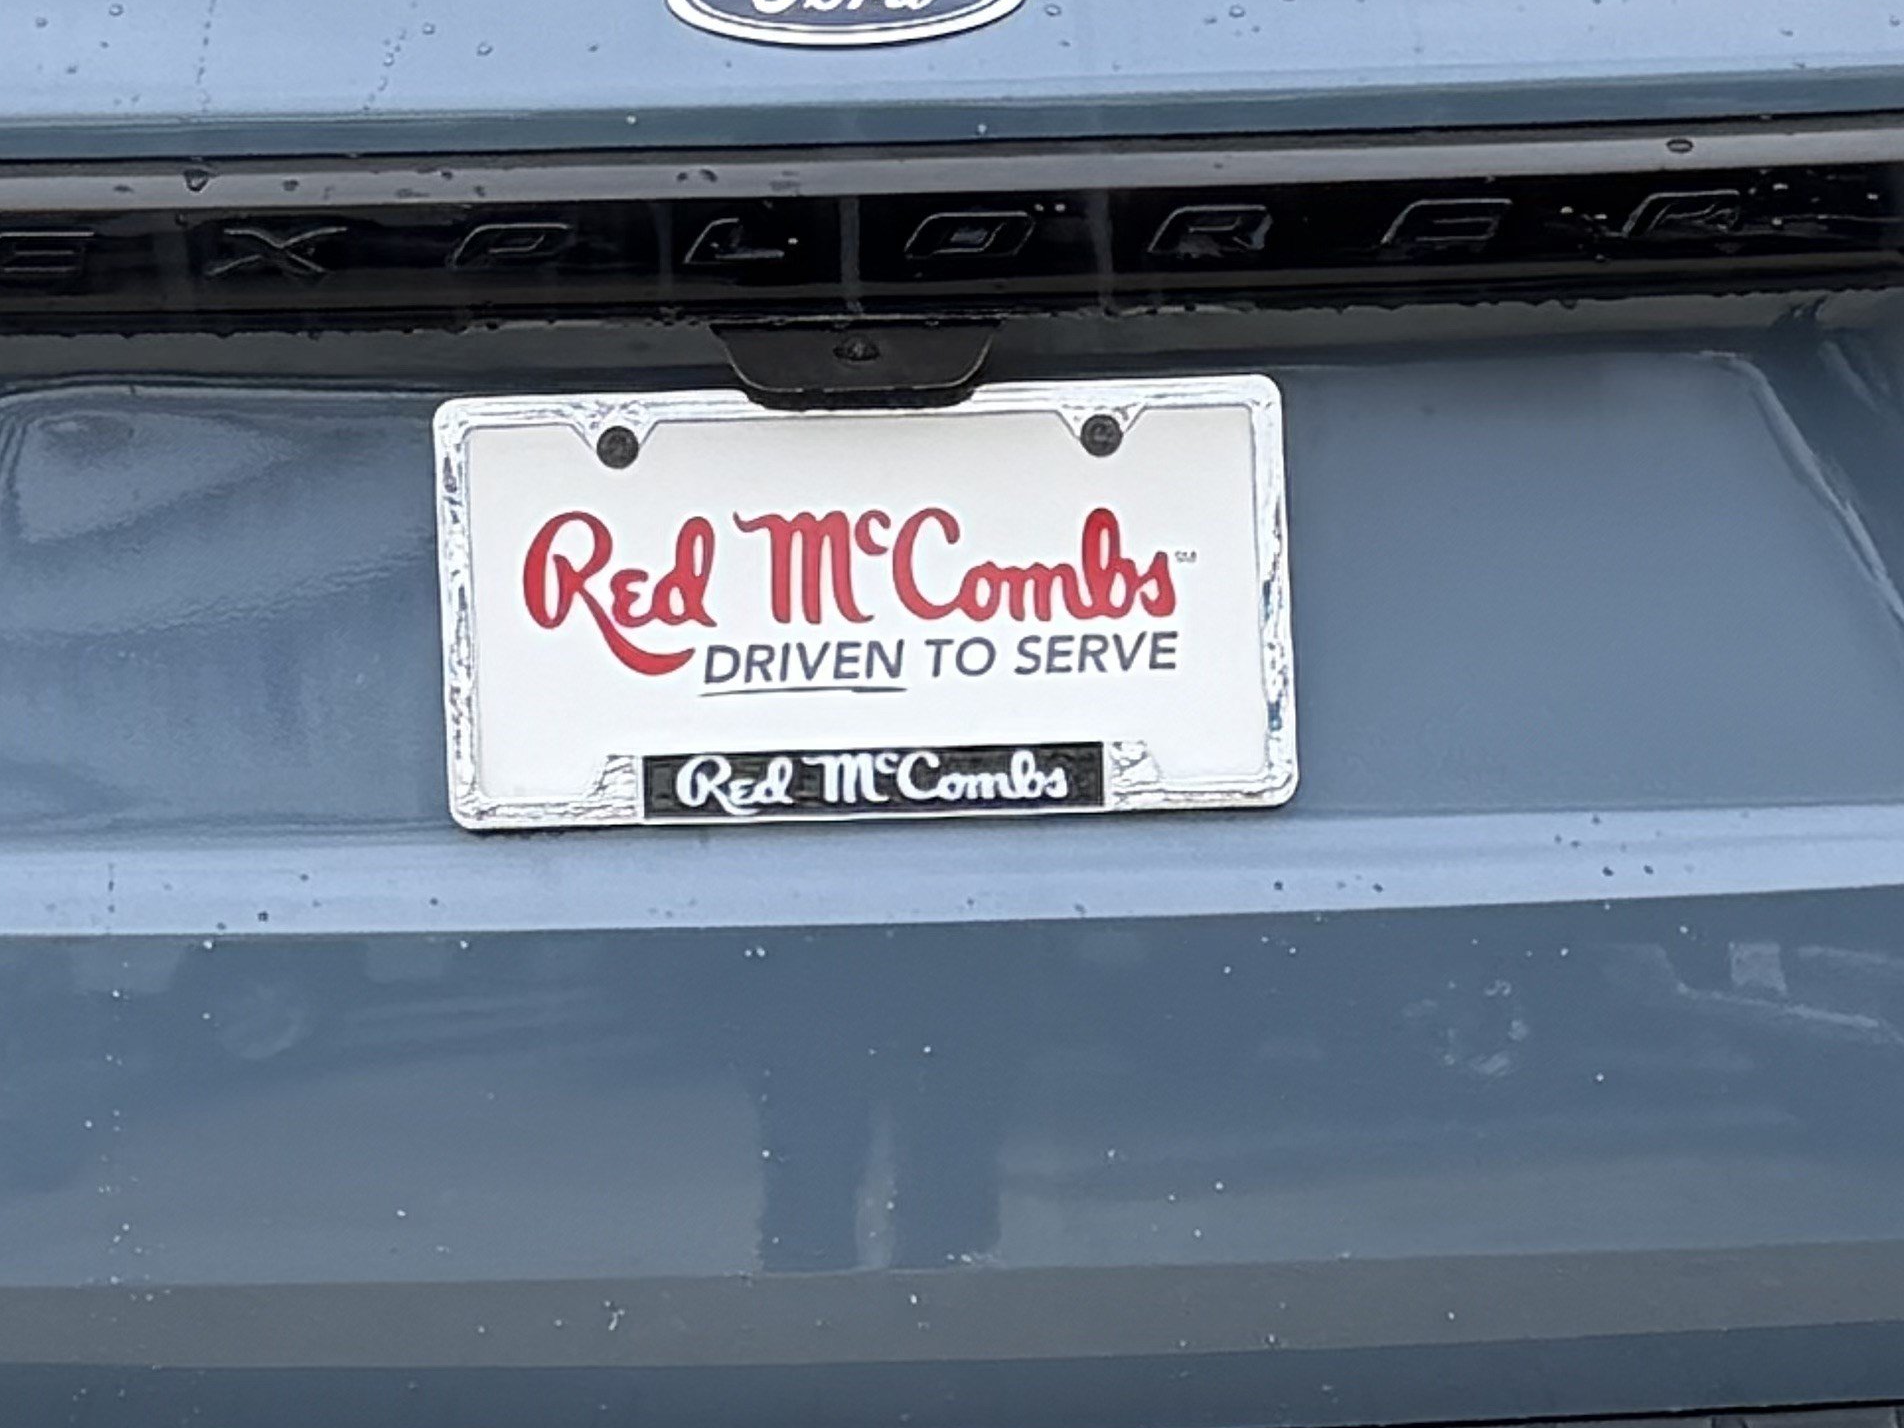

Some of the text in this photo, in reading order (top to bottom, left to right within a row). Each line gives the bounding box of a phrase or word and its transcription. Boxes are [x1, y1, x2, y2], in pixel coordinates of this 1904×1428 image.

[523, 507, 1176, 676] Red McCombs
[703, 630, 1179, 685] DRIVEN TO SERVE
[675, 750, 1070, 816] Red McCombs
